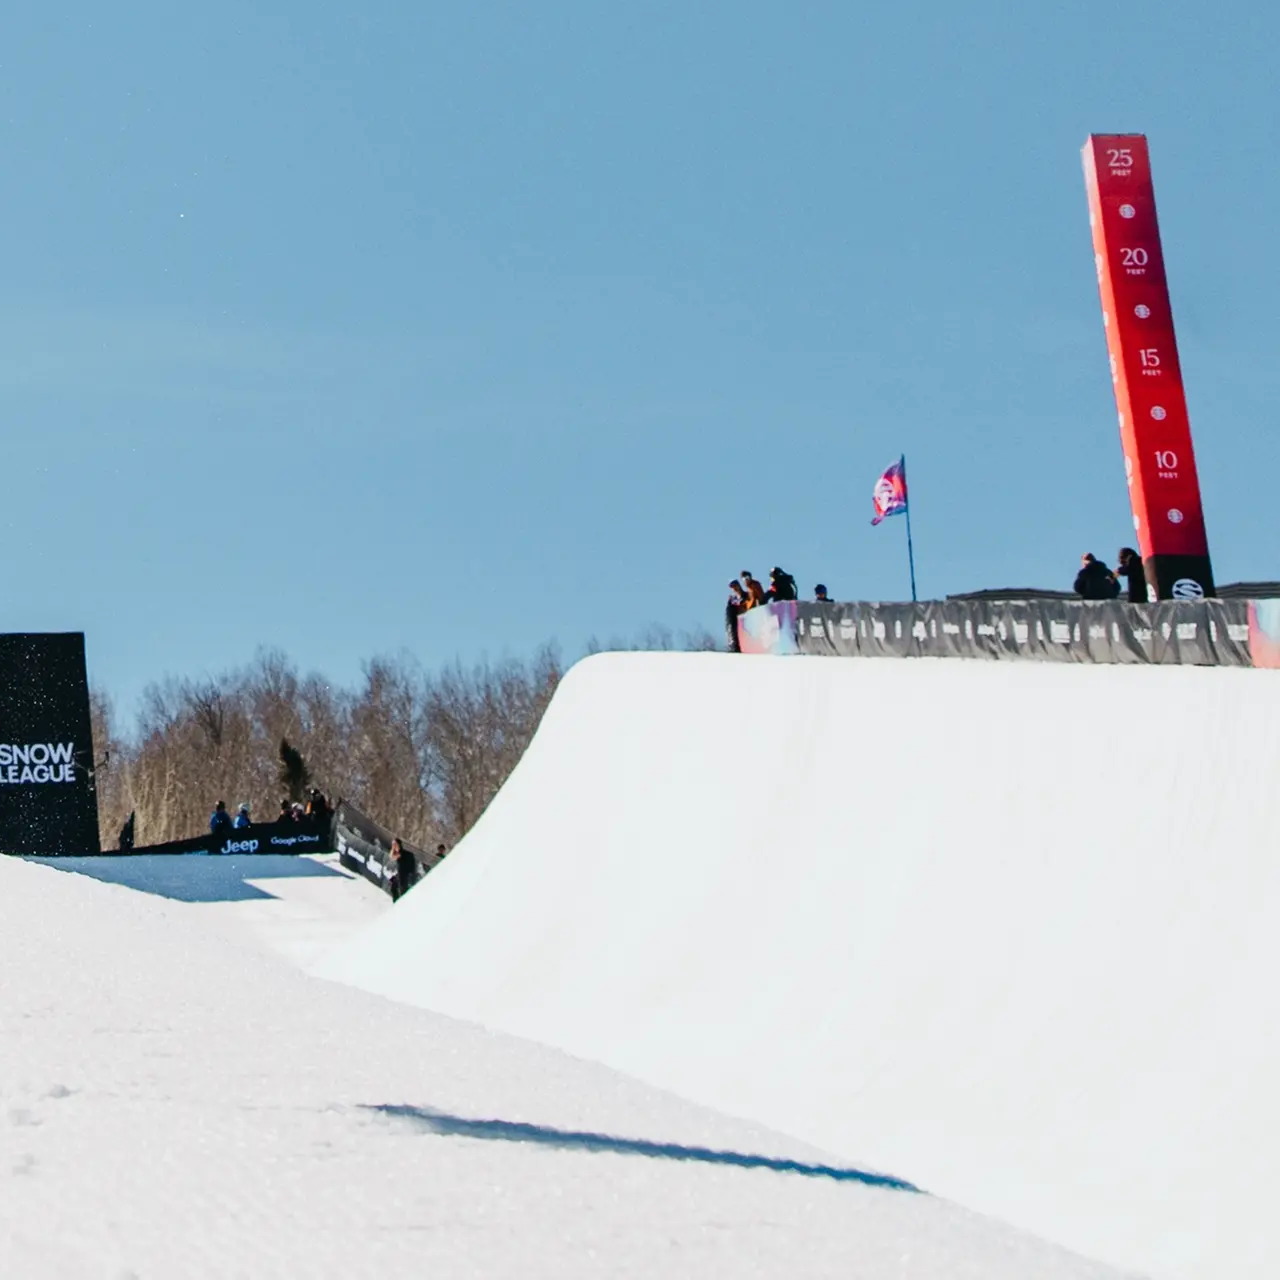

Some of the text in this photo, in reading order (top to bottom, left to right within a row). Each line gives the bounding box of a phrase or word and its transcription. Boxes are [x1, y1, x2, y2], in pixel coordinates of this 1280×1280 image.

[1107, 149, 1133, 167] 25
[1120, 248, 1148, 266] 20
[1140, 349, 1160, 367] 15
[1155, 451, 1177, 469] 10
[221, 838, 259, 854] Jeep
